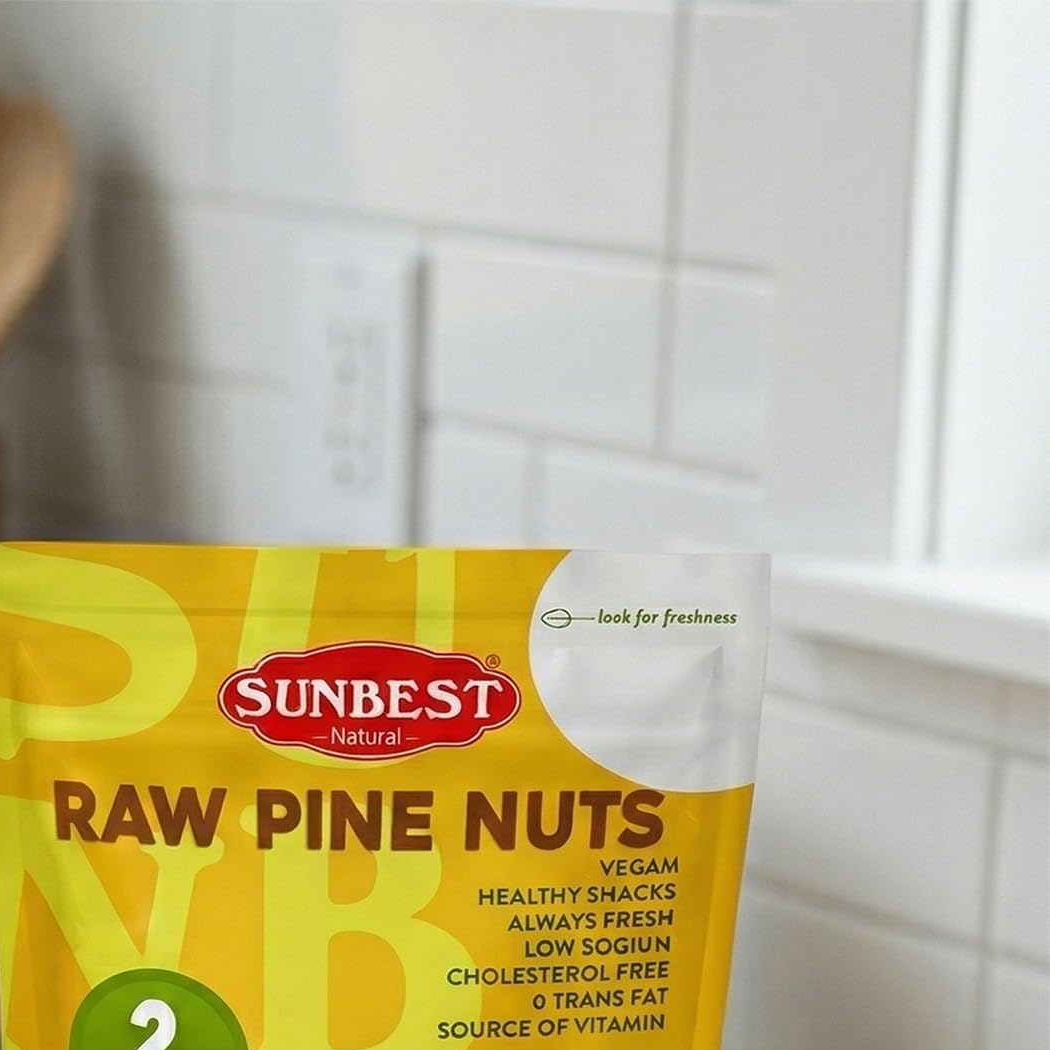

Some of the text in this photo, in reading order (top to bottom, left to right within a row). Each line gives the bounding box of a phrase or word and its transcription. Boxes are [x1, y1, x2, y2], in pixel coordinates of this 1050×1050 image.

[598, 608, 738, 629] look for freshness
[234, 677, 504, 721] SUNBEST
[330, 727, 401, 746] Natural
[54, 780, 665, 852] RAW PINE NUTS
[600, 856, 679, 876] VEGAM
[478, 883, 676, 906] HEALTHY SHACKS
[508, 909, 674, 932] ALWAYS FRESH
[525, 936, 671, 958] LOW SOGIUN
[446, 961, 670, 986] CHOLESTEROL FREE
[552, 990, 624, 1009] TRANS
[630, 987, 669, 1006] FAT
[437, 1014, 665, 1039] SOURCE OF VITAMIN
